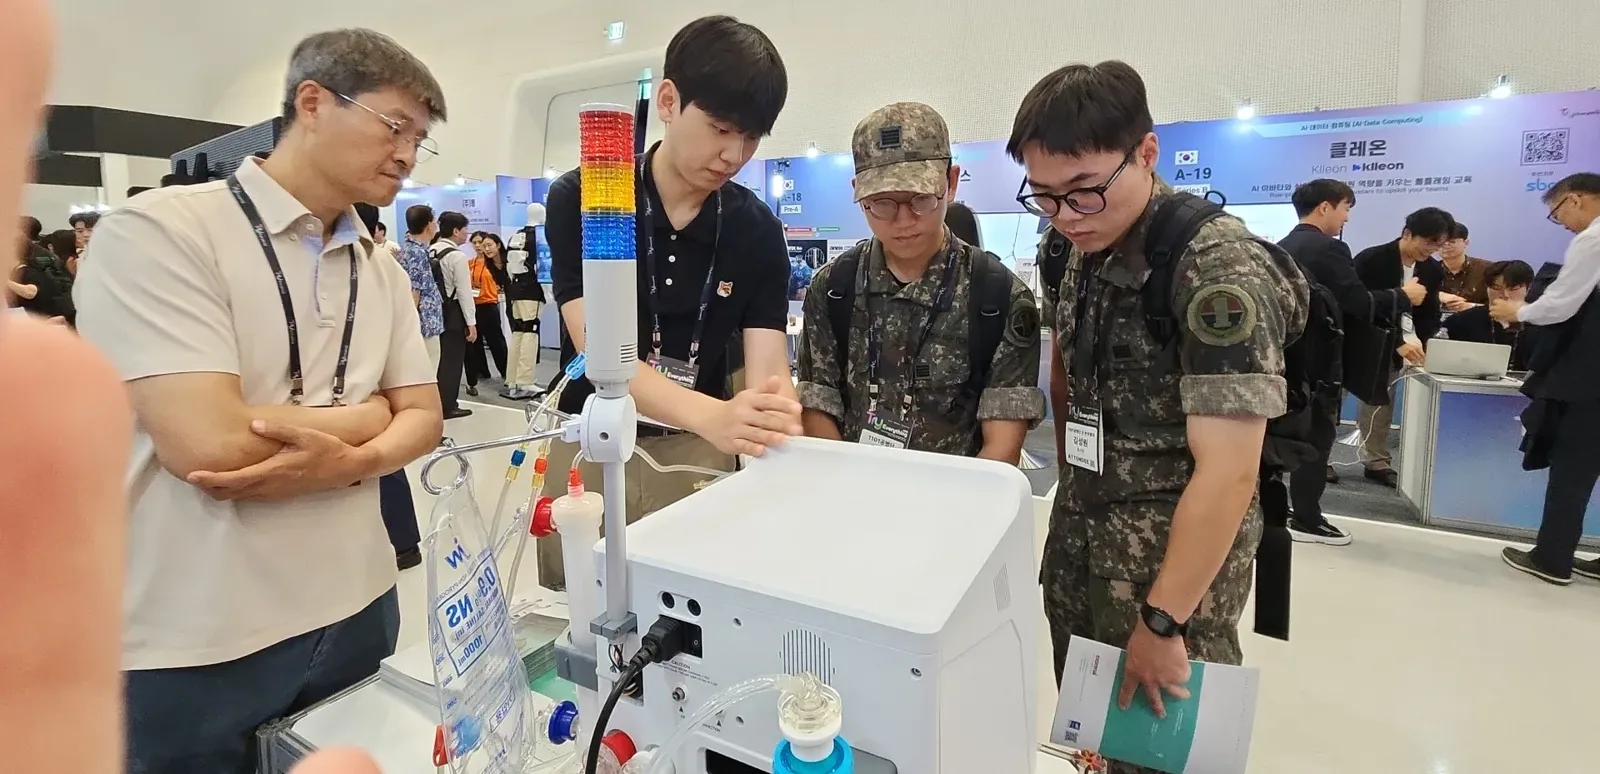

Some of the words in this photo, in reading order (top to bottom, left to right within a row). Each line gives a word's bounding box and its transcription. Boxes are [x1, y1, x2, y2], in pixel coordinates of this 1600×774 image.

[1329, 139, 1387, 159] 클레온
[1174, 167, 1212, 181] A-19
[781, 192, 802, 202] A-18
[866, 410, 884, 430] Try
